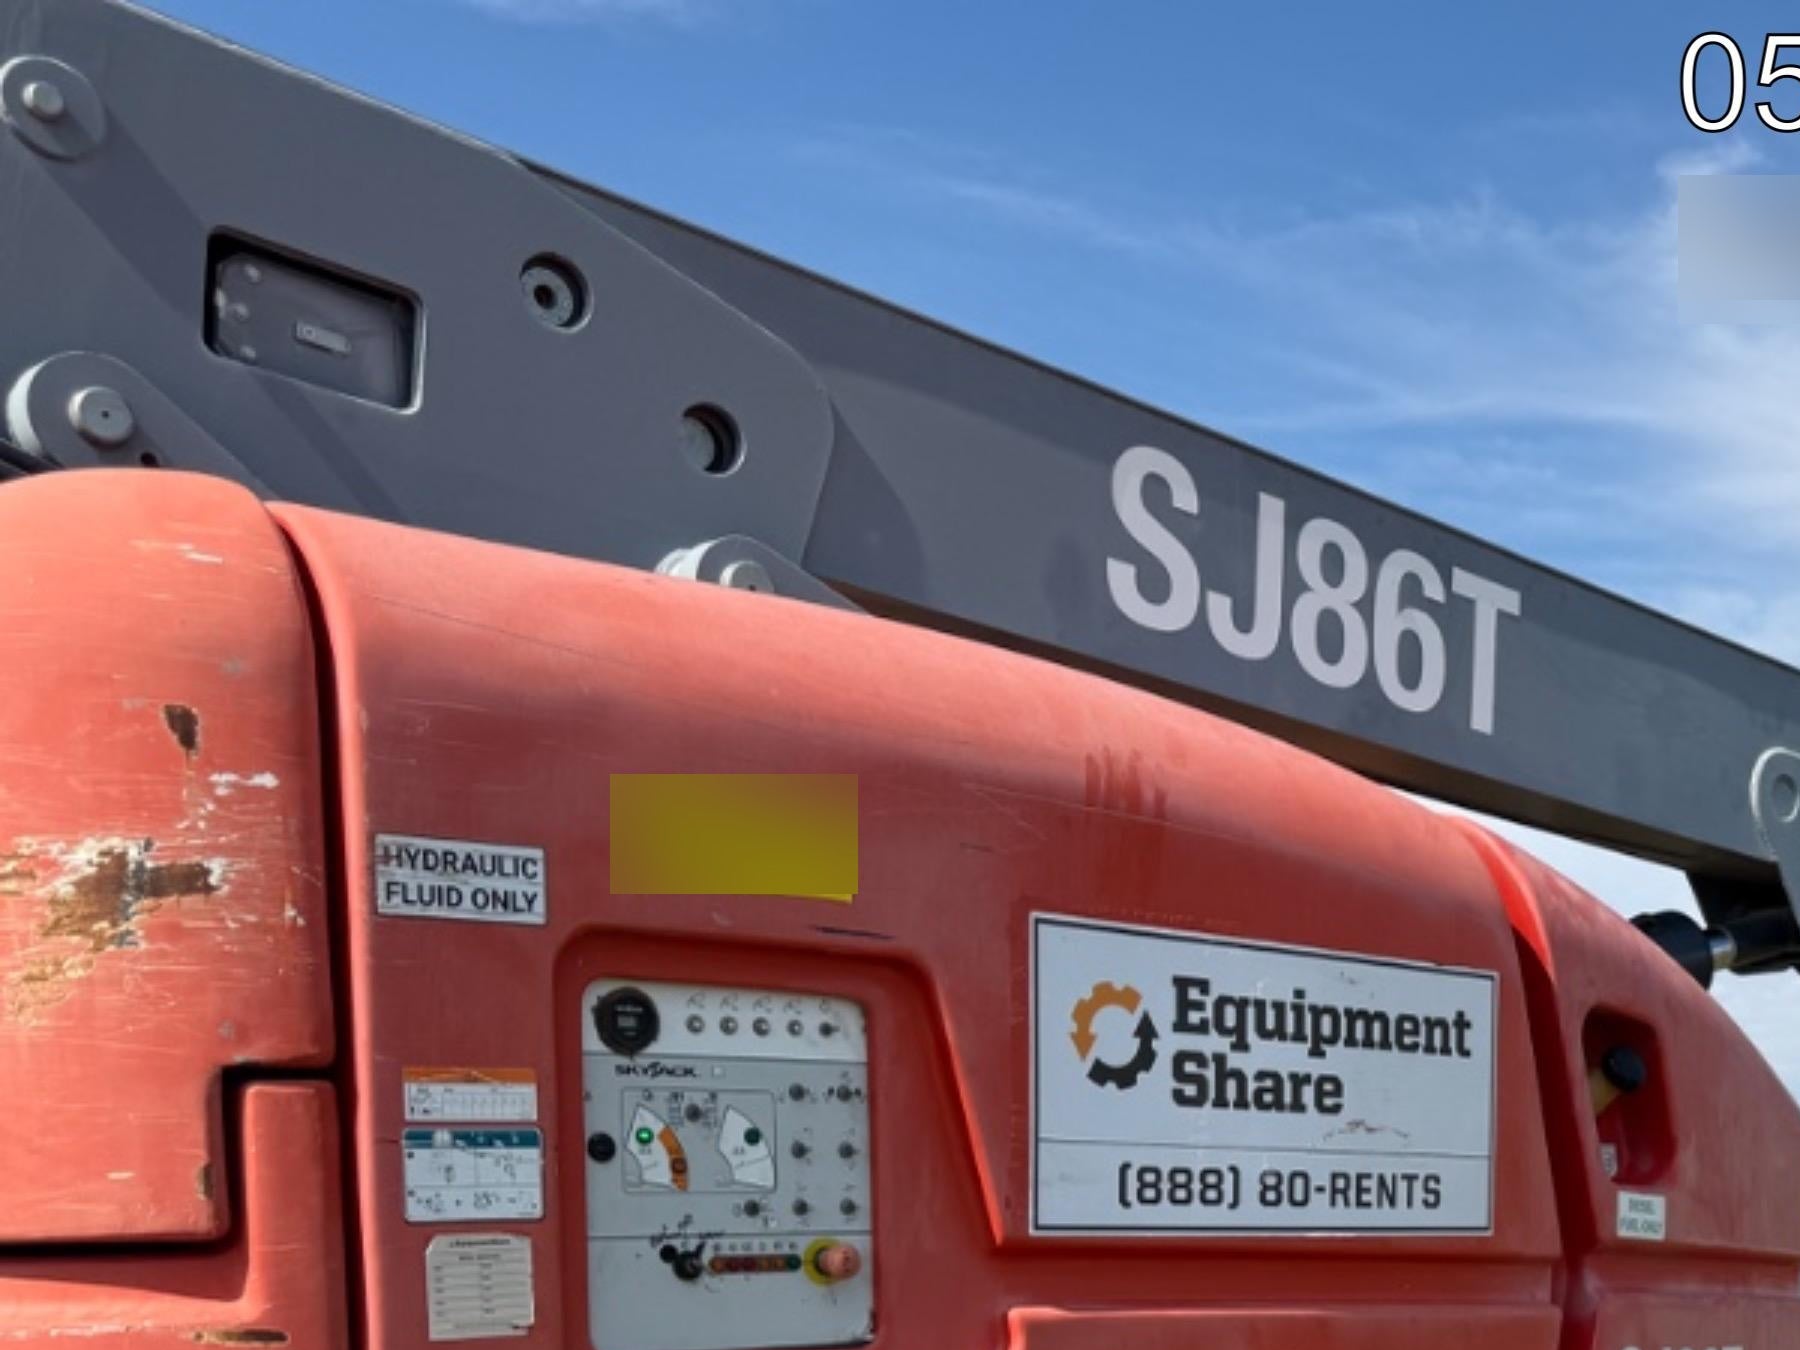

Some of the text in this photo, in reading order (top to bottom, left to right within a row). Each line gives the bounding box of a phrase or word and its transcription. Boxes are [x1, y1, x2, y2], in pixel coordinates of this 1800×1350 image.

[1106, 445, 1521, 736] SJ86T
[381, 845, 539, 880] HYDRAULIC
[385, 881, 538, 913] FLUID ONLY
[1172, 975, 1472, 1058] Equipment
[1172, 1049, 1343, 1115] Share
[1118, 1162, 1441, 1210] (888) 80-RENTS
